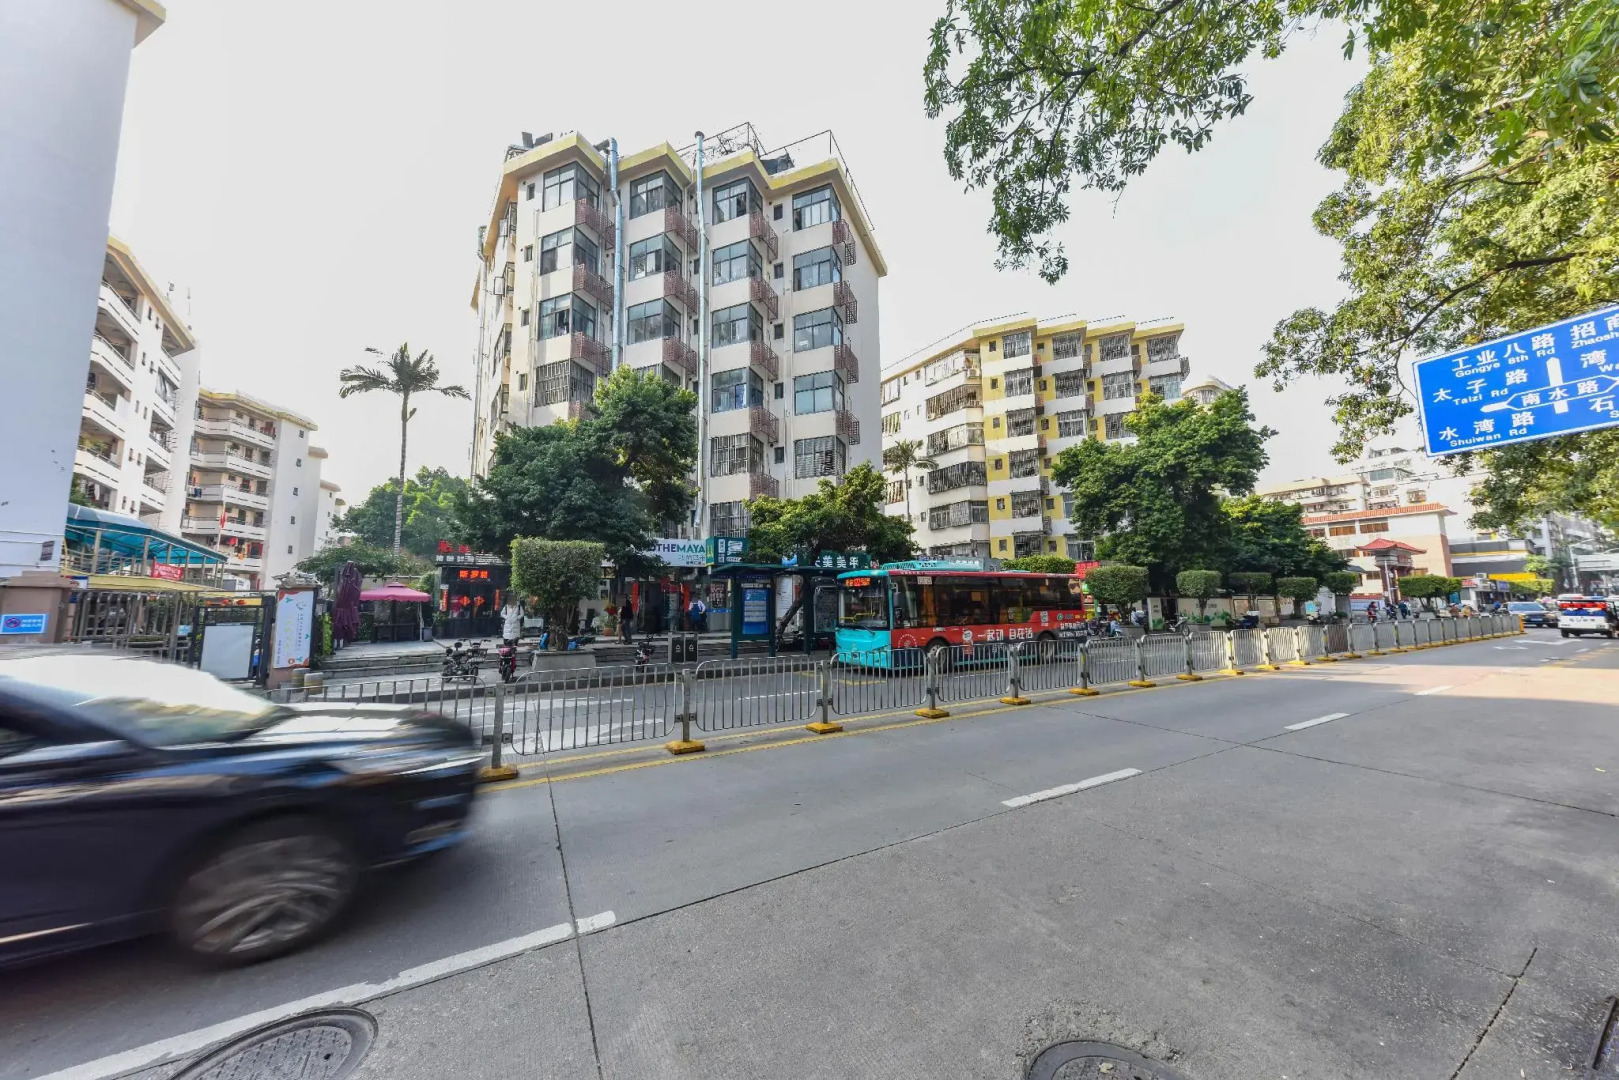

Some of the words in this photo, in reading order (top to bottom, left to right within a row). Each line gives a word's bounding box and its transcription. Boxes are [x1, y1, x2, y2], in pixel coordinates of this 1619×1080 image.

[1451, 332, 1555, 372] 工业八路
[1455, 361, 1500, 378] Gongye
[1508, 355, 1529, 365] 8th
[1536, 347, 1556, 358] Rd
[1432, 368, 1529, 403] 太子路
[1452, 394, 1483, 406] Taizi
[1491, 388, 1509, 398] Rd
[1521, 380, 1599, 407] 南水路
[1588, 395, 1616, 412] 石
[1439, 411, 1535, 441] 水湾路
[1450, 432, 1501, 447] Shuiwan
[1509, 427, 1528, 437] Rd
